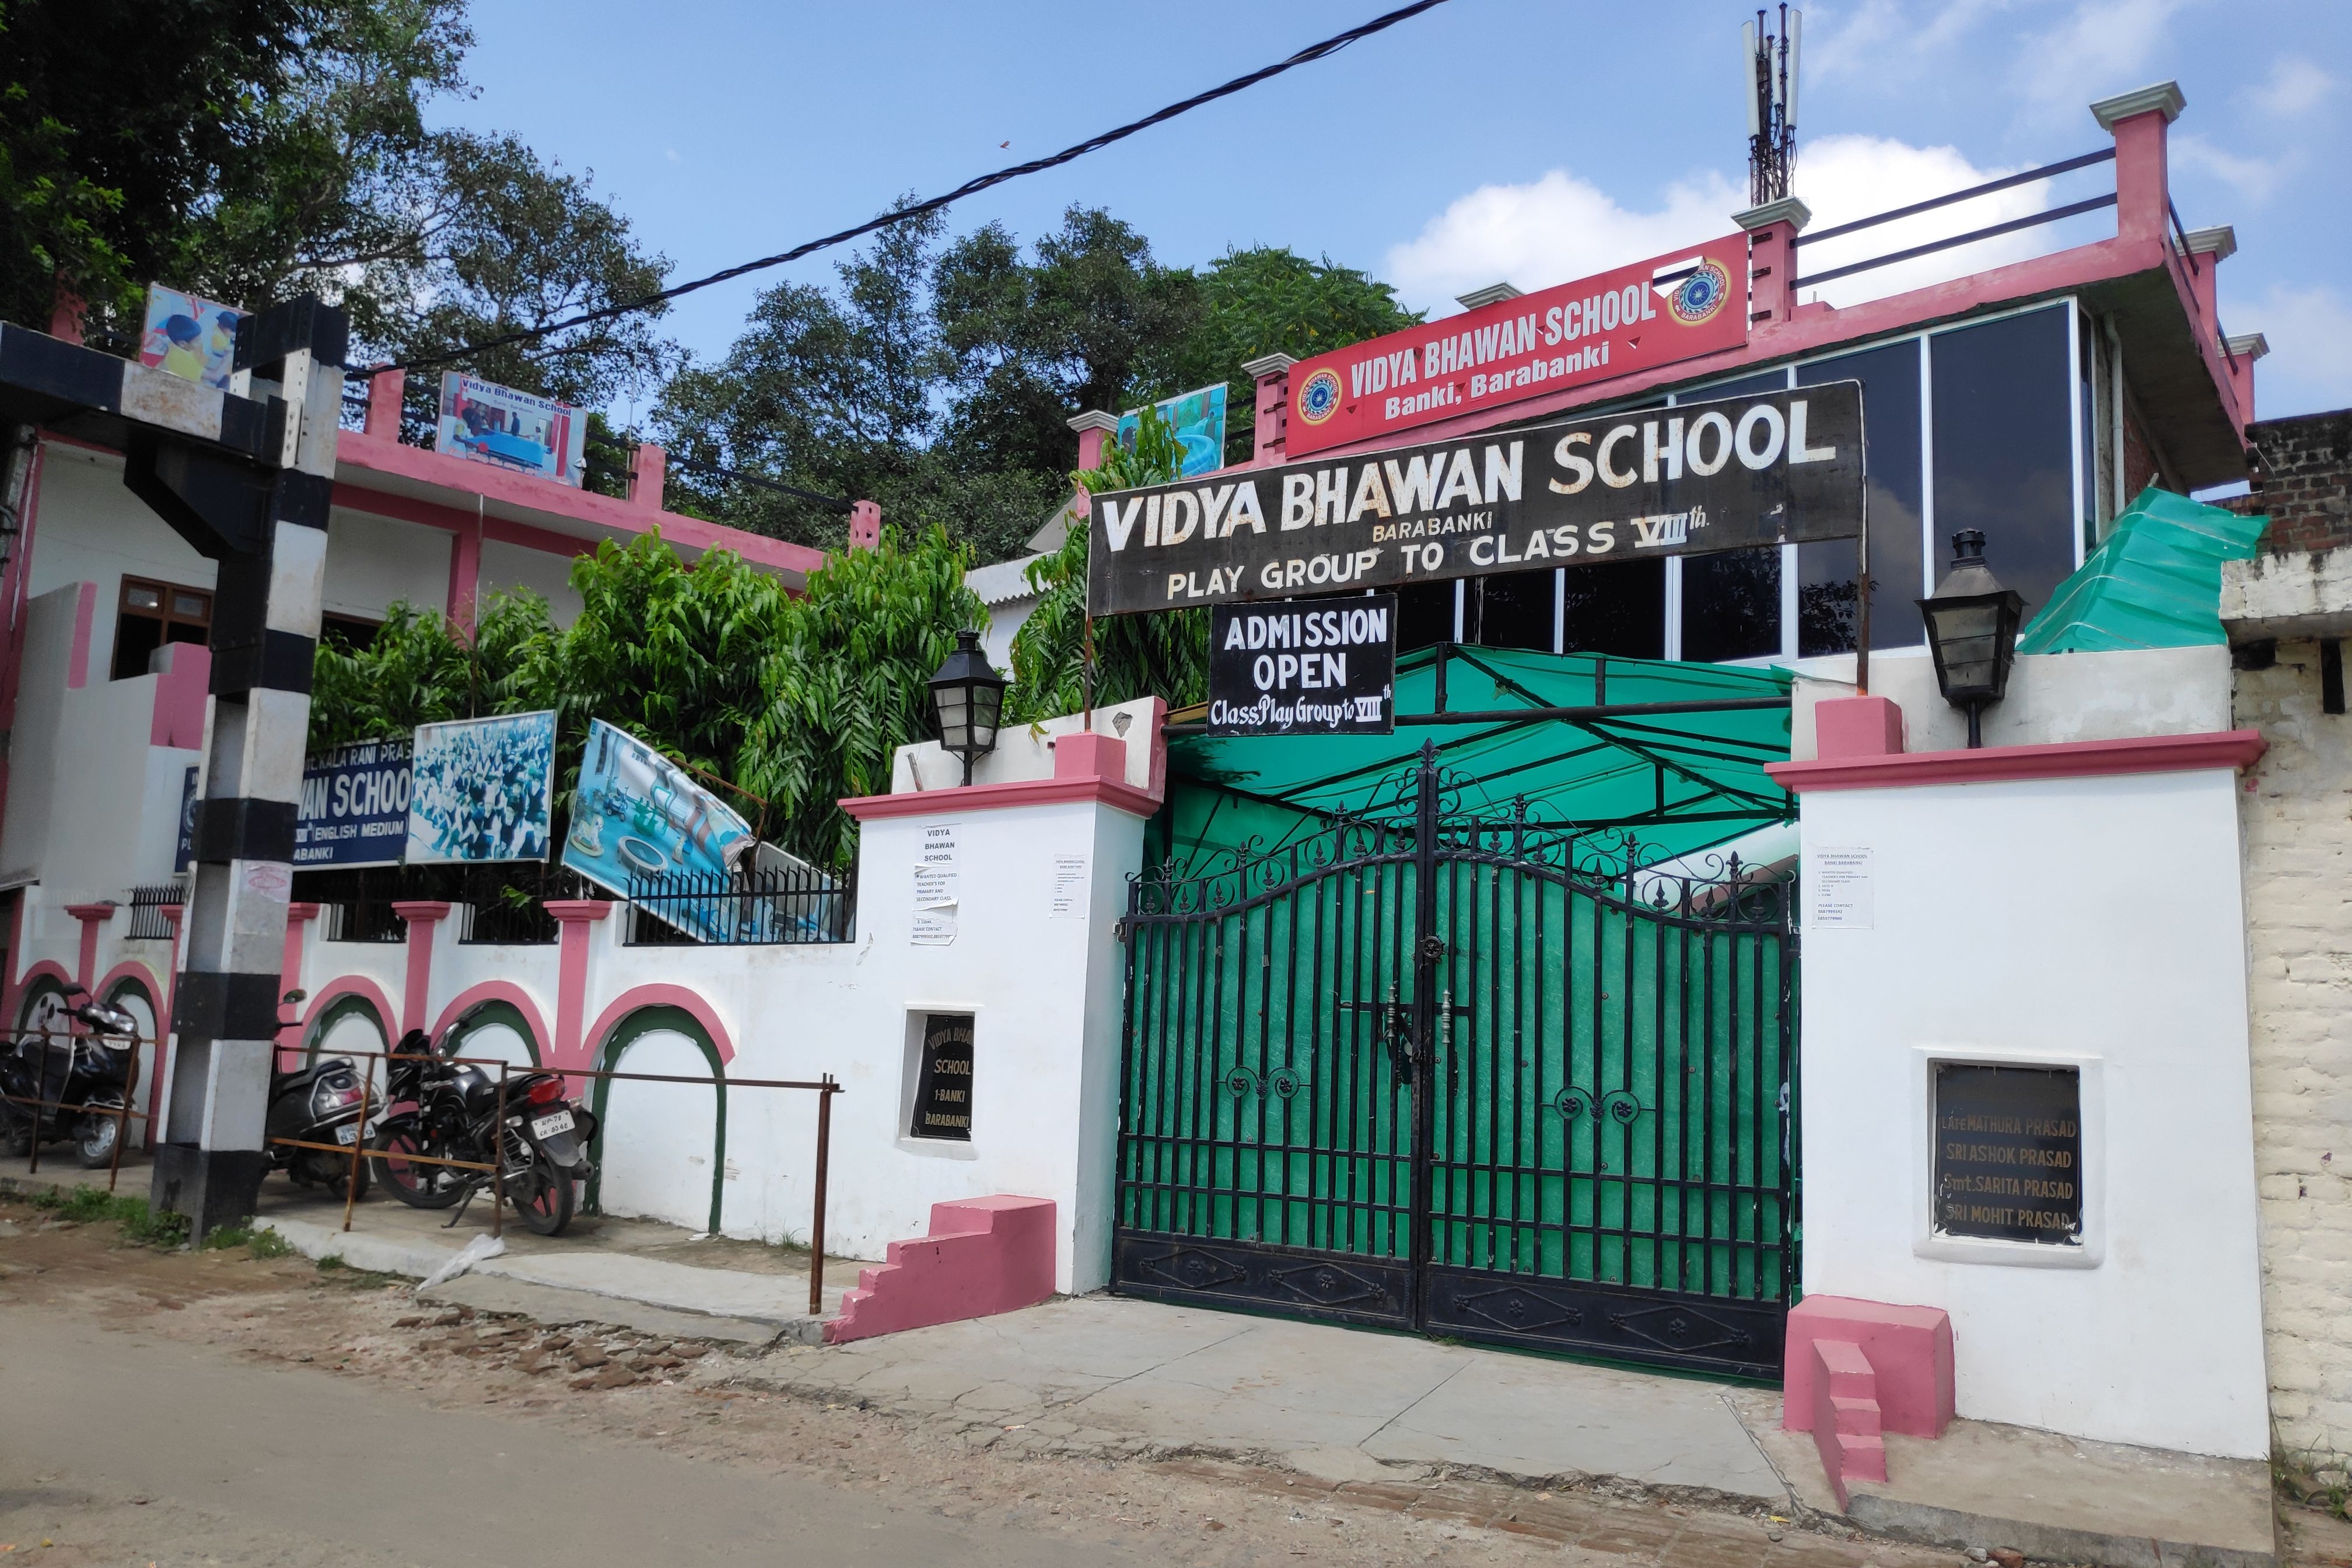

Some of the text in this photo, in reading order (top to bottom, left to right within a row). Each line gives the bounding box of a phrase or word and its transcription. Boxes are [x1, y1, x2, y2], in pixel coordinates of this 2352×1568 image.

[1710, 267, 1726, 289] SCHOOL
[1681, 304, 1717, 321] BARABANKI
[1351, 281, 1656, 399] VIDYA BHAWAN SCHOOL
[1301, 387, 1310, 403] VIDYA
[1327, 374, 1339, 394] SCHOOL
[1385, 341, 1610, 421] Banki, Barabanki
[462, 379, 572, 418] Vidya Bhawan School
[1306, 408, 1332, 421] BARABANKI
[1102, 400, 1837, 552] VIDYA BHAWAN SCHOOL
[1373, 512, 1493, 543] BARABANKI
[1167, 565, 1245, 601] PLAY
[1261, 552, 1378, 590] GROUP
[1400, 542, 1445, 573] TO
[1469, 521, 1615, 566] CLASS
[1224, 608, 1387, 650] ADMISSION
[1254, 653, 1346, 691] OPEN
[1210, 699, 1260, 725] Class
[1256, 694, 1294, 729] Play
[1296, 695, 1343, 729] Group
[1342, 698, 1355, 721] to
[350, 746, 377, 766] RANI
[927, 828, 950, 837] VIDYA
[924, 853, 953, 862] SCHOOL
[925, 841, 955, 850] BHAWAN
[928, 1028, 951, 1051] VIDYA
[934, 1059, 971, 1075] SCHOOL
[925, 1111, 970, 1128] BARABANKI
[1967, 1115, 2022, 1134] MATHURA
[2026, 1118, 2077, 1138] PRASAD
[1946, 1143, 2072, 1168] SRI ASHOK PRASAD
[1975, 1175, 2020, 1196] SARITA
[2024, 1179, 2074, 1200] PRASAD
[1945, 1204, 2070, 1230] SRI MOHIT PRASAD
